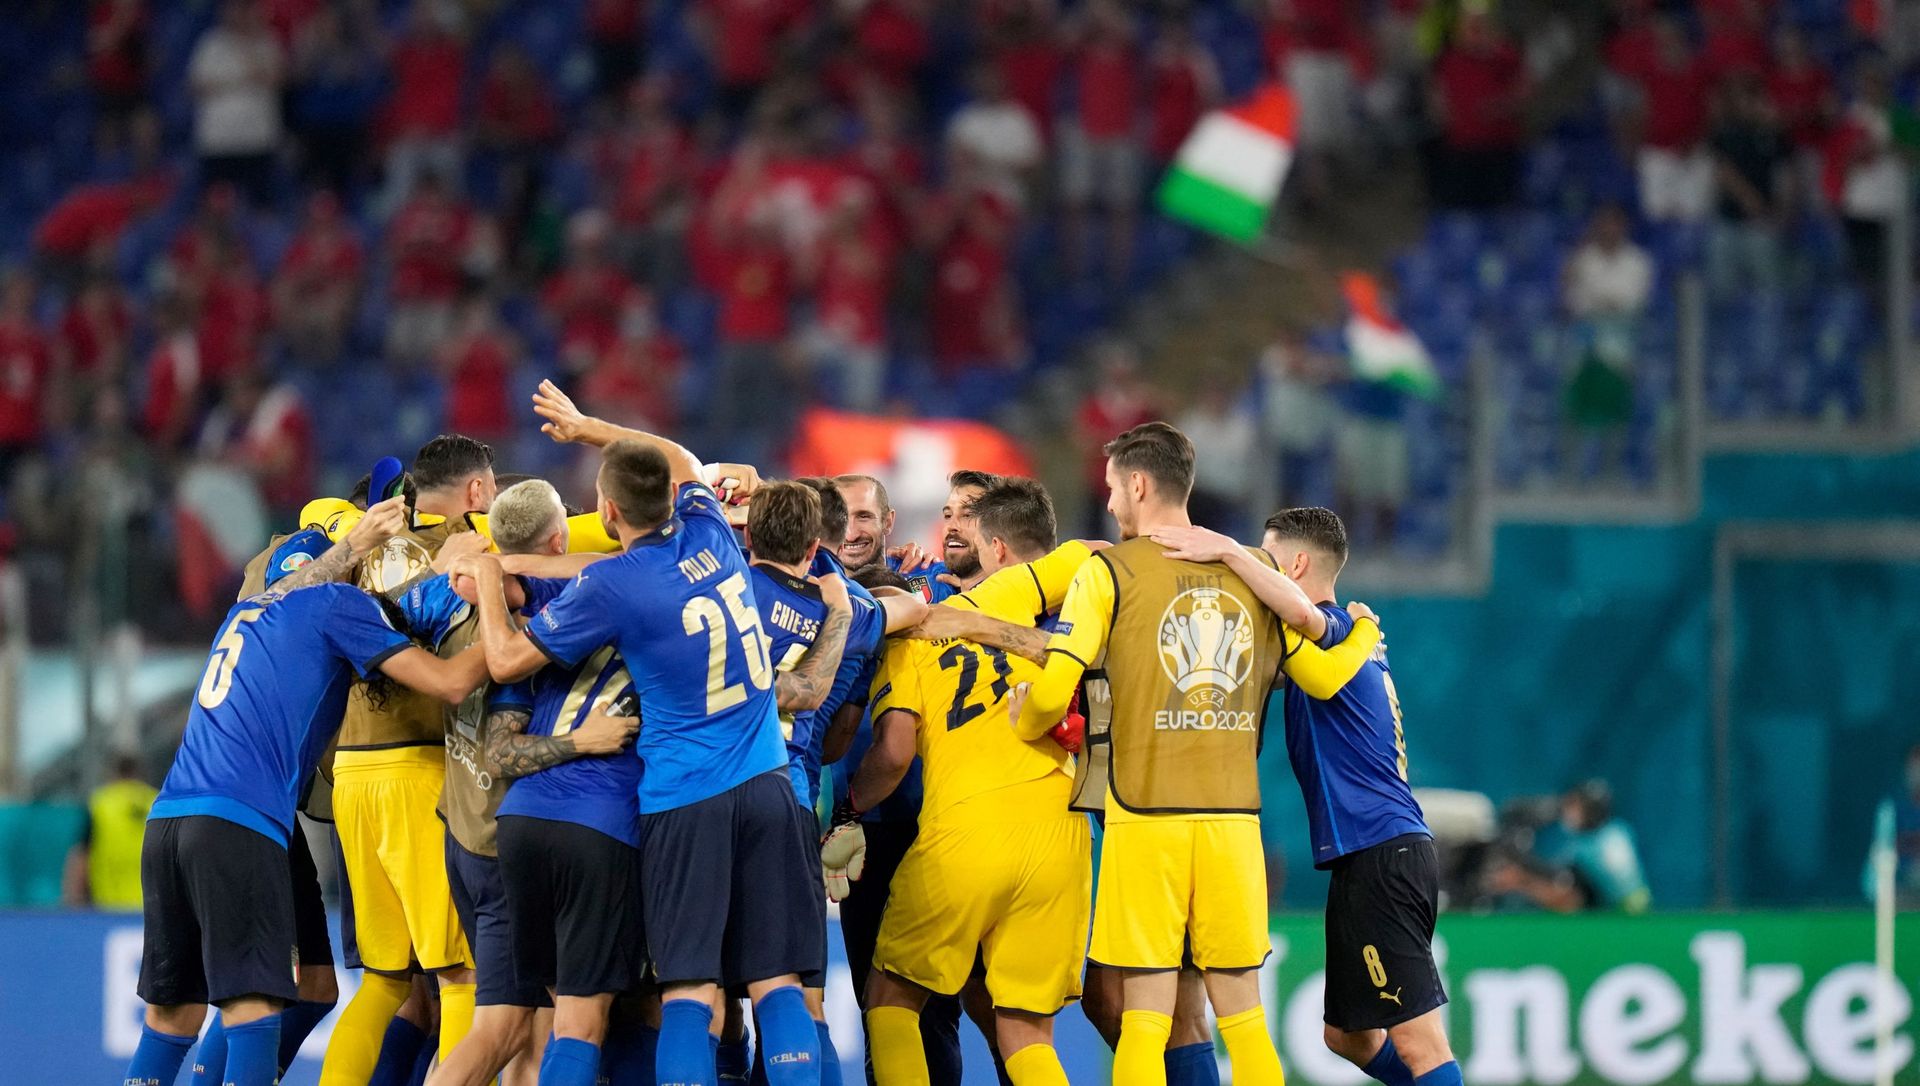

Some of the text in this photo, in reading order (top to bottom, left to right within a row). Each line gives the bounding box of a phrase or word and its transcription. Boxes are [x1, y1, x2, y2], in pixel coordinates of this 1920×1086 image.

[678, 548, 721, 584] TOLOI
[198, 607, 266, 709] 5
[682, 571, 774, 716] 25
[1189, 691, 1225, 706] UEFA
[1363, 944, 1387, 987] 8
[1215, 930, 1914, 1085] neke
